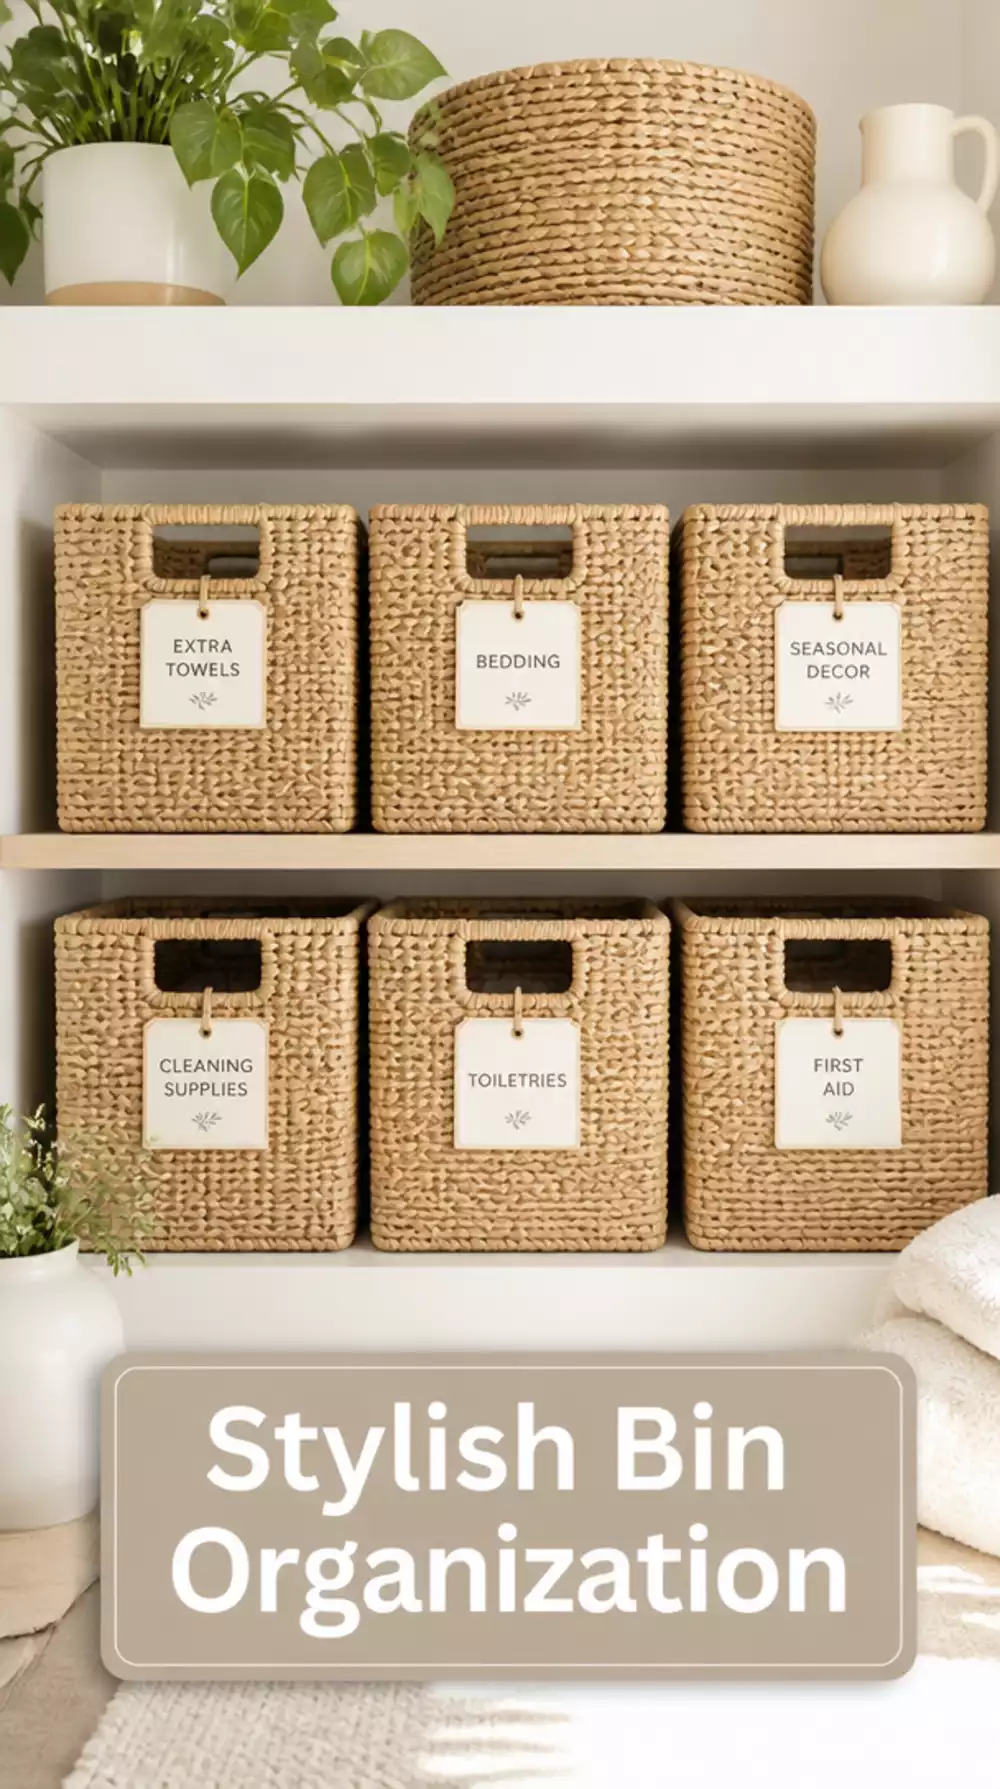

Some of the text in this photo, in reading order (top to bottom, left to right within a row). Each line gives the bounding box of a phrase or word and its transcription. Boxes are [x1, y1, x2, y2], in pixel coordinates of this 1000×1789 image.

[173, 639, 233, 654] EXTRA
[790, 641, 887, 656] SEASONAL
[476, 654, 560, 669] BEDDING
[166, 662, 240, 677] TOWELS
[807, 664, 870, 679] DECOR
[159, 1058, 253, 1074] CLEANING
[814, 1058, 863, 1073] FIRST
[468, 1073, 567, 1088] TOILETRIES
[164, 1081, 248, 1097] SUPPLIES
[823, 1082, 855, 1096] AID
